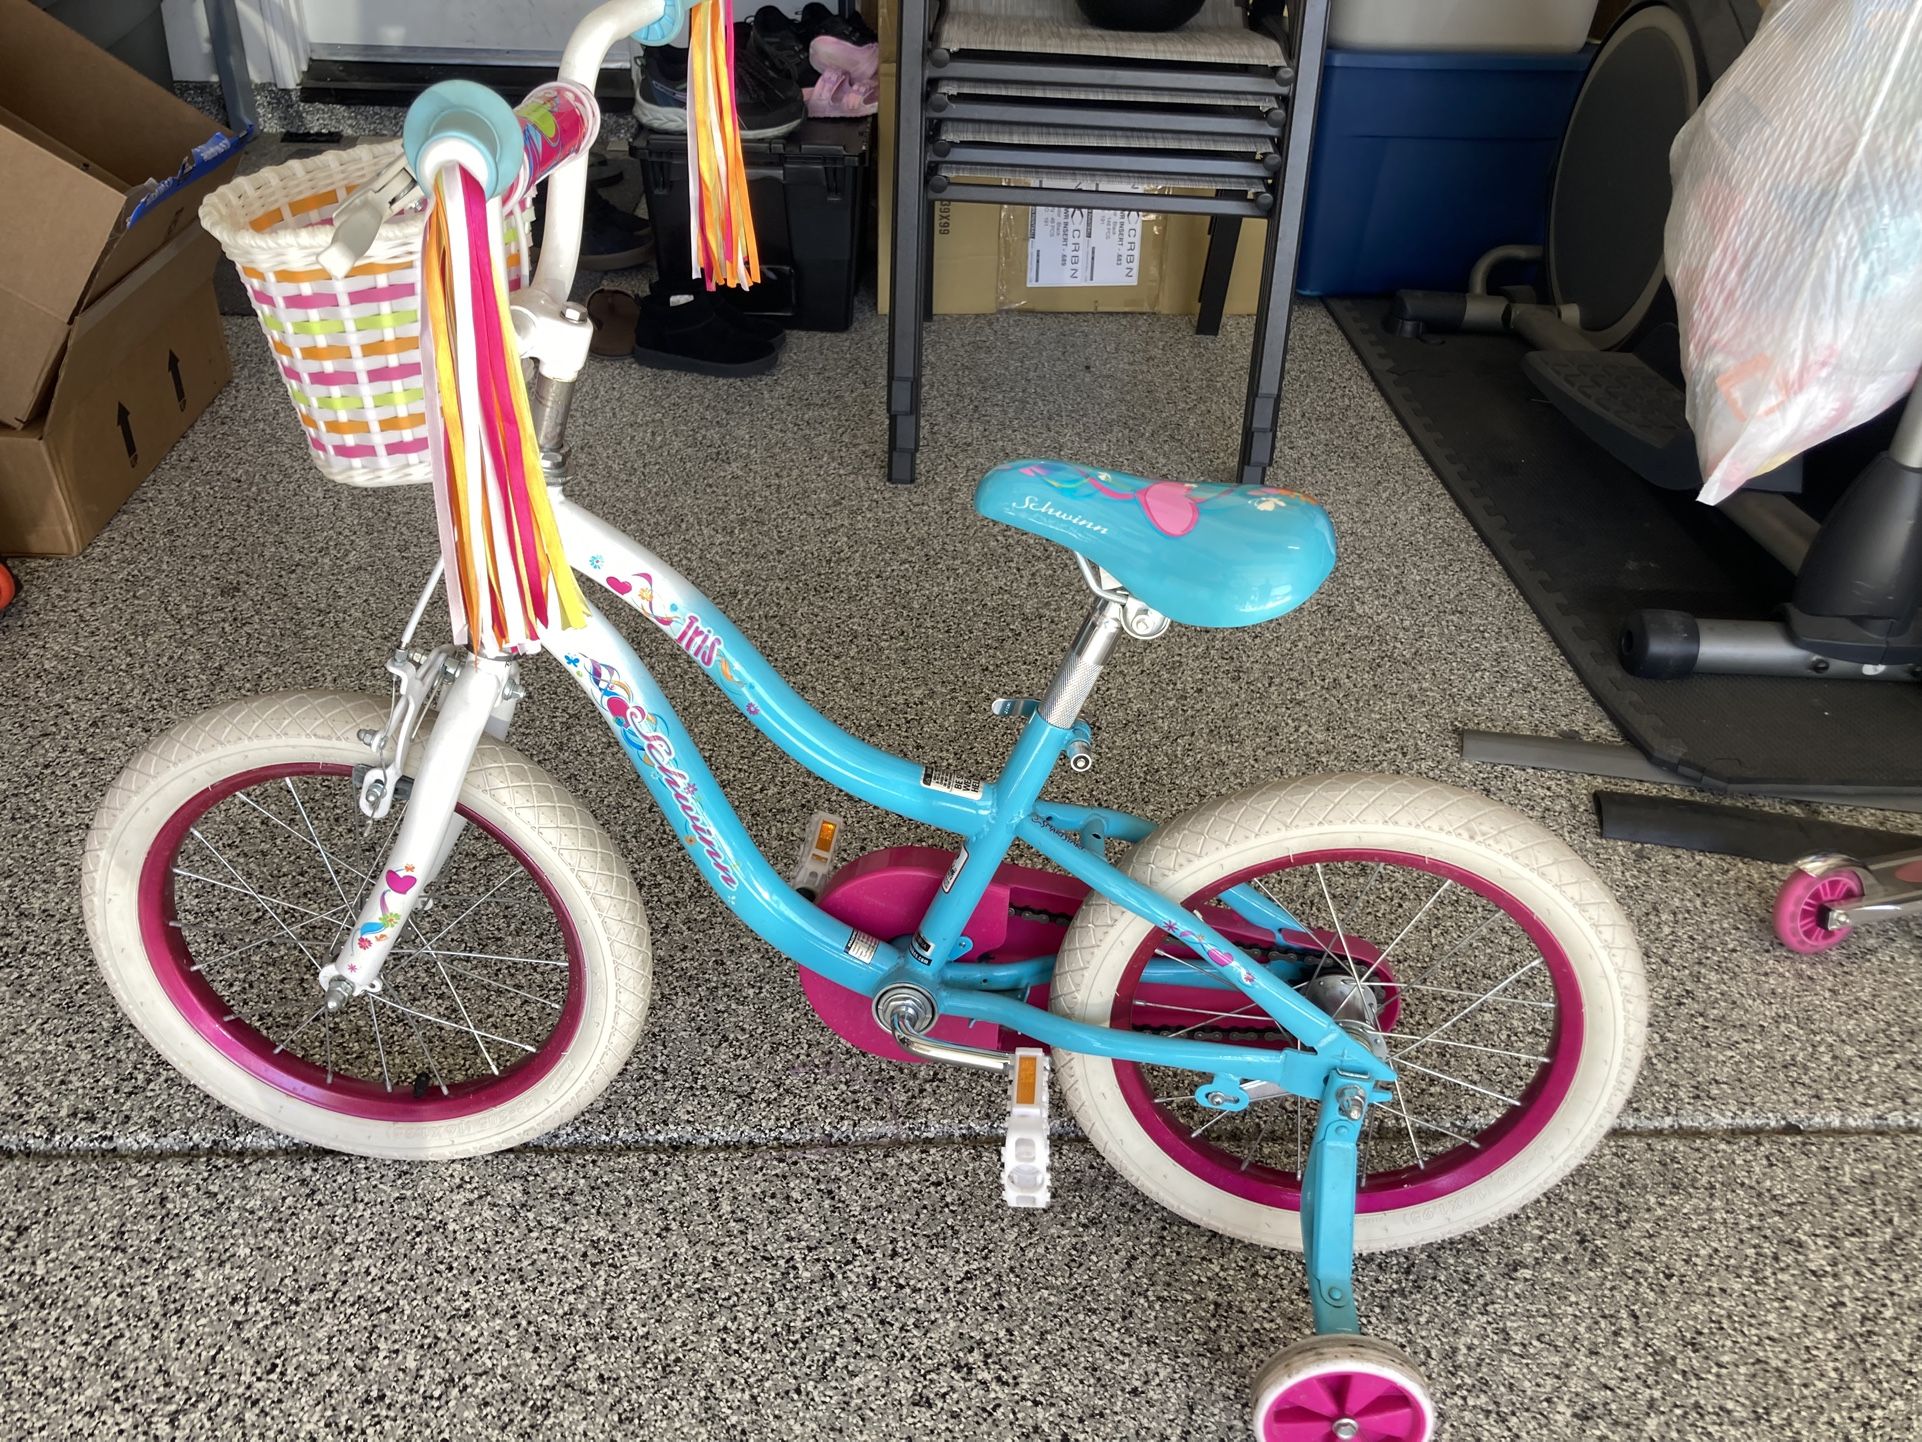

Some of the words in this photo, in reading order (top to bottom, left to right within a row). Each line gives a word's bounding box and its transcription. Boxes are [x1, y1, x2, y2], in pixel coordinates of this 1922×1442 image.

[1070, 229, 1080, 279] CRBN
[1125, 228, 1137, 277] CRBN
[1012, 495, 1108, 534] Schwinn
[677, 615, 722, 667] Iris
[627, 705, 738, 890] Schwinn
